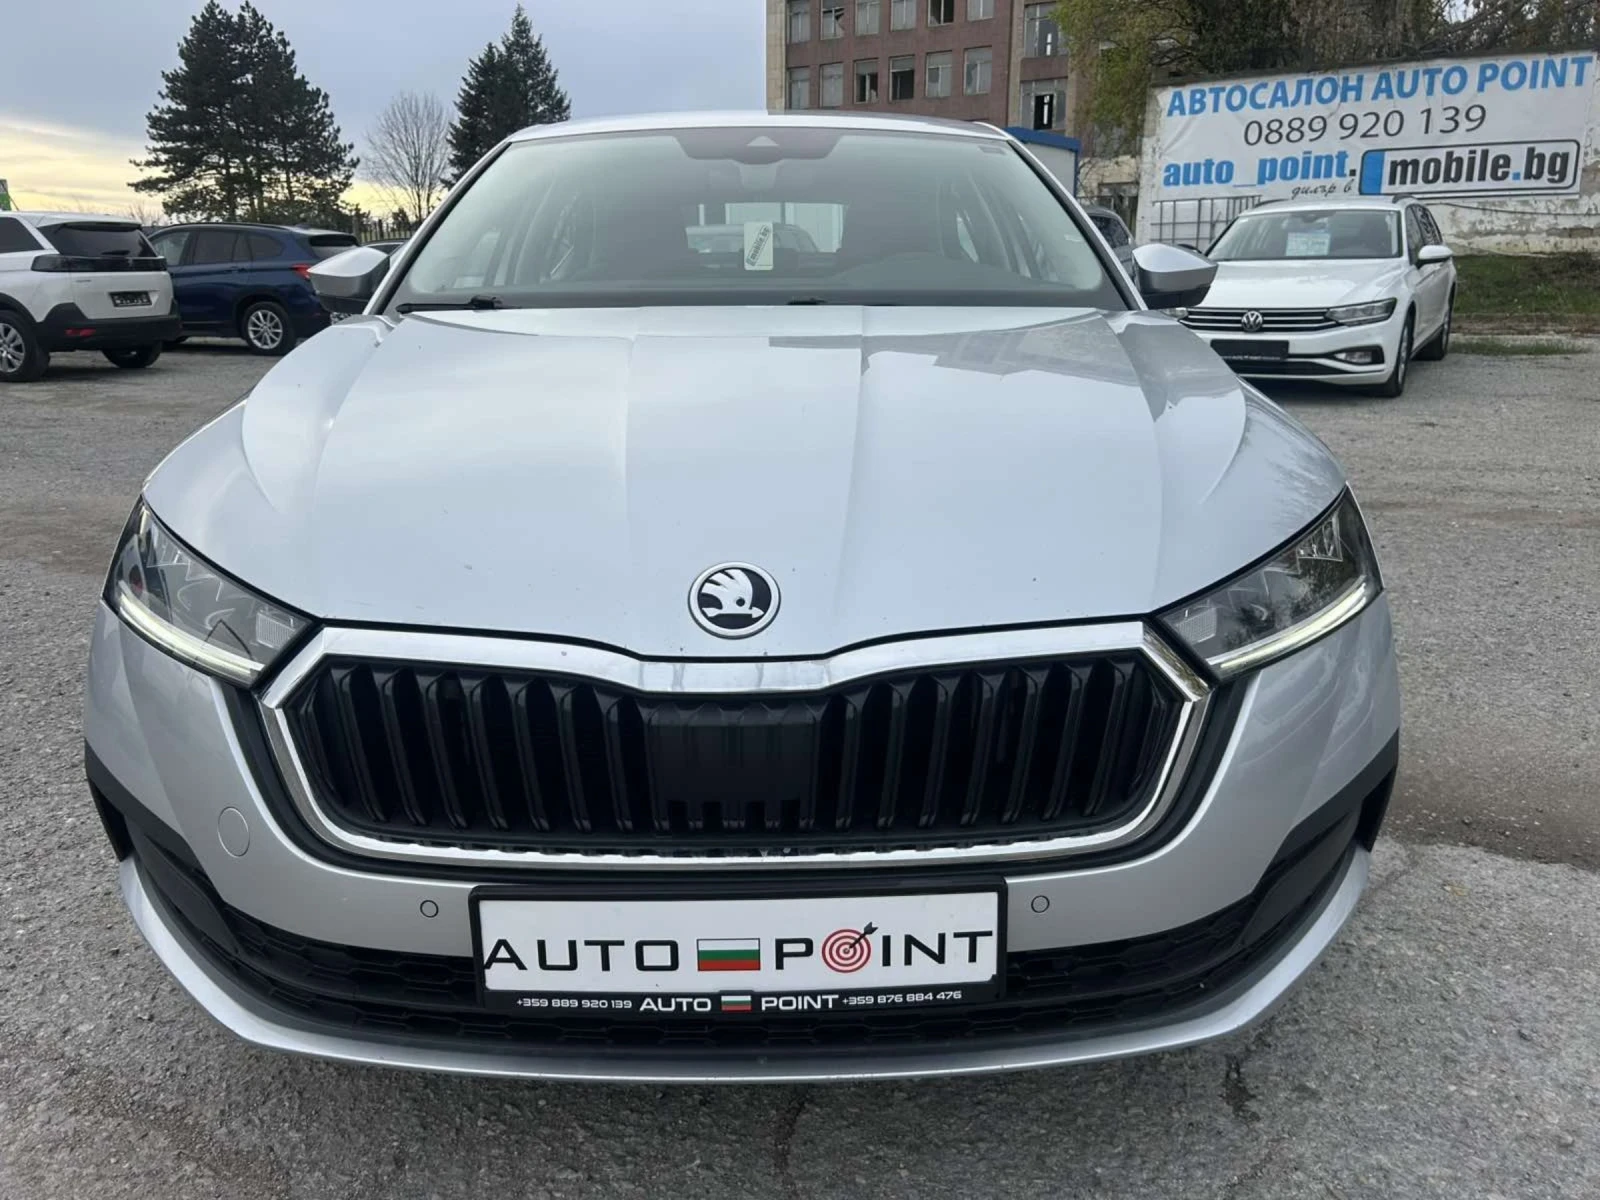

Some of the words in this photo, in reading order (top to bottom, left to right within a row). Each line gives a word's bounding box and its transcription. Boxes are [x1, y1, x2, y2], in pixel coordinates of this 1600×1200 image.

[1167, 74, 1364, 117] АВТОСАЛОН
[1371, 65, 1469, 101] AUTO
[1476, 56, 1593, 93] POINT
[1244, 115, 1327, 146] 0889
[1339, 109, 1404, 140] 920
[1420, 104, 1487, 135] 139
[1388, 147, 1569, 184] mobile.bg
[483, 938, 680, 972] AUTO
[516, 998, 549, 1007] +359
[551, 998, 579, 1008] 889
[581, 999, 608, 1008] 920
[611, 1000, 632, 1009] 139
[639, 998, 712, 1012] AUTO
[761, 994, 840, 1011] POINT
[842, 996, 875, 1005] +359
[877, 994, 903, 1003] 876
[906, 992, 933, 1002] 884
[936, 991, 962, 1000] 476
